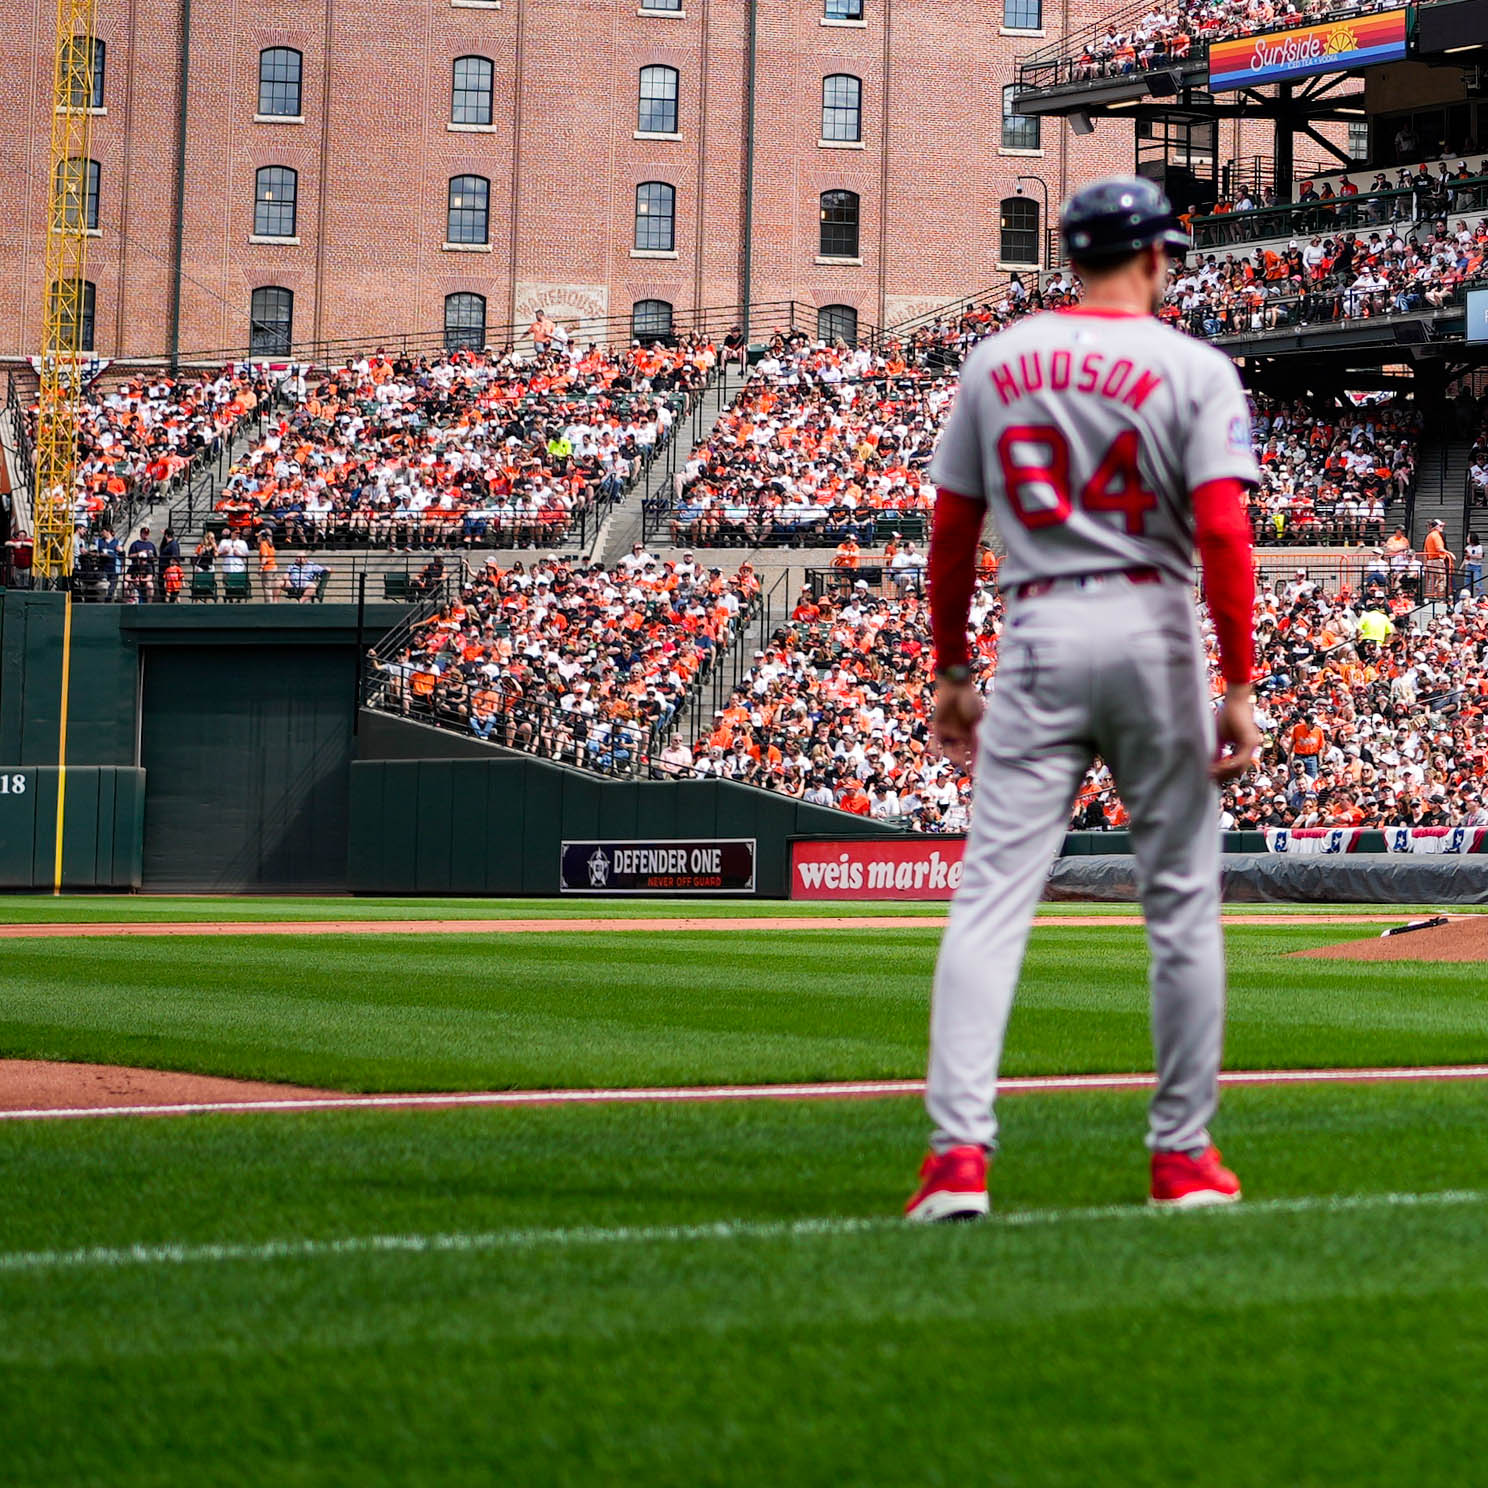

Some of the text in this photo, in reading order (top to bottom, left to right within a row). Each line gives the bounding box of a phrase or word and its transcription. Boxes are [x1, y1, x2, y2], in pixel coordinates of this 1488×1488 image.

[1251, 32, 1320, 72] Surfside
[990, 351, 1163, 411] HUDSON
[997, 424, 1159, 535] 84
[0, 774, 26, 794] 18
[613, 848, 722, 875] DEFENDER ONE
[797, 851, 964, 890] weis marke
[647, 875, 722, 888] NEVER OFF GUARD
